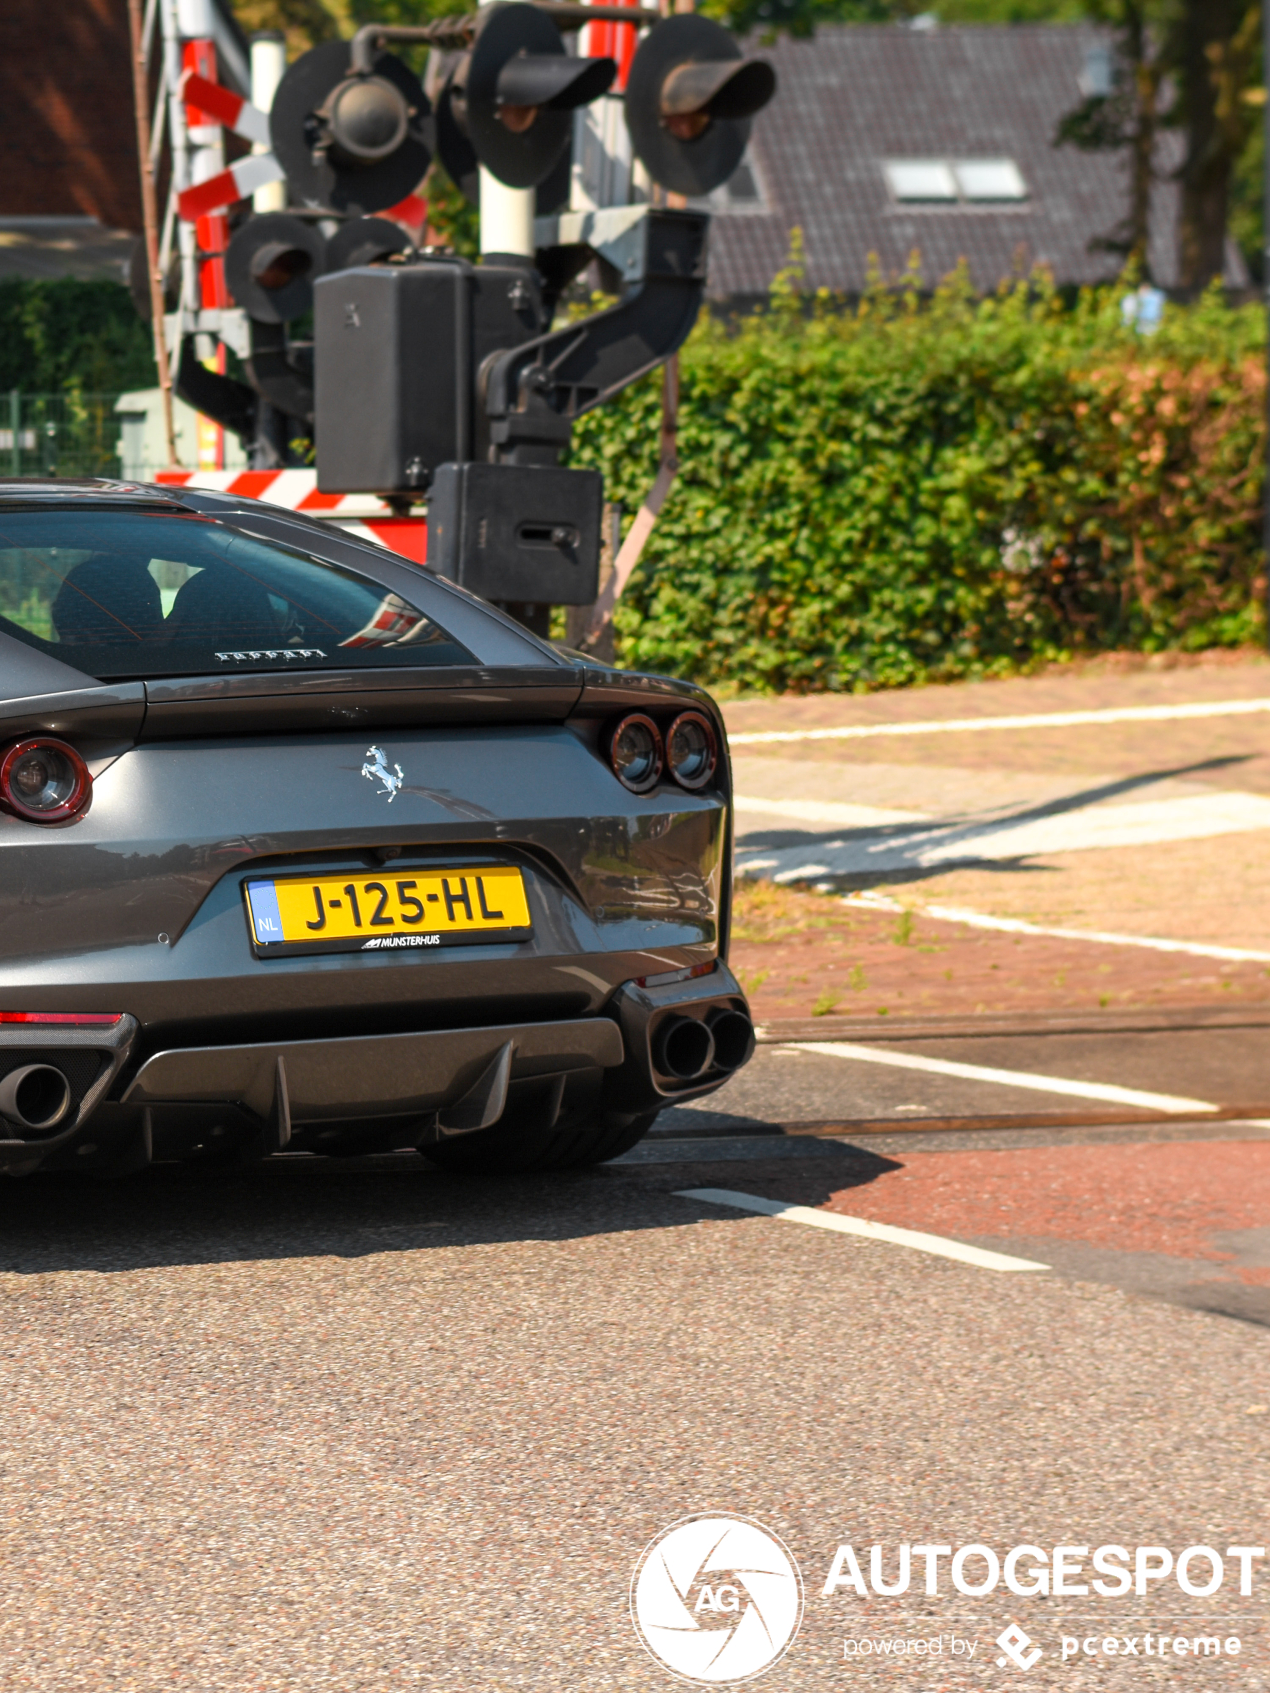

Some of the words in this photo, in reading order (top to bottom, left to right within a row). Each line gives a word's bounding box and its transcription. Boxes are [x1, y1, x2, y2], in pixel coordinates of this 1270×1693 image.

[306, 876, 504, 930] J-125-HL
[259, 917, 278, 932] NL
[381, 934, 440, 948] MUNSTERHUIS
